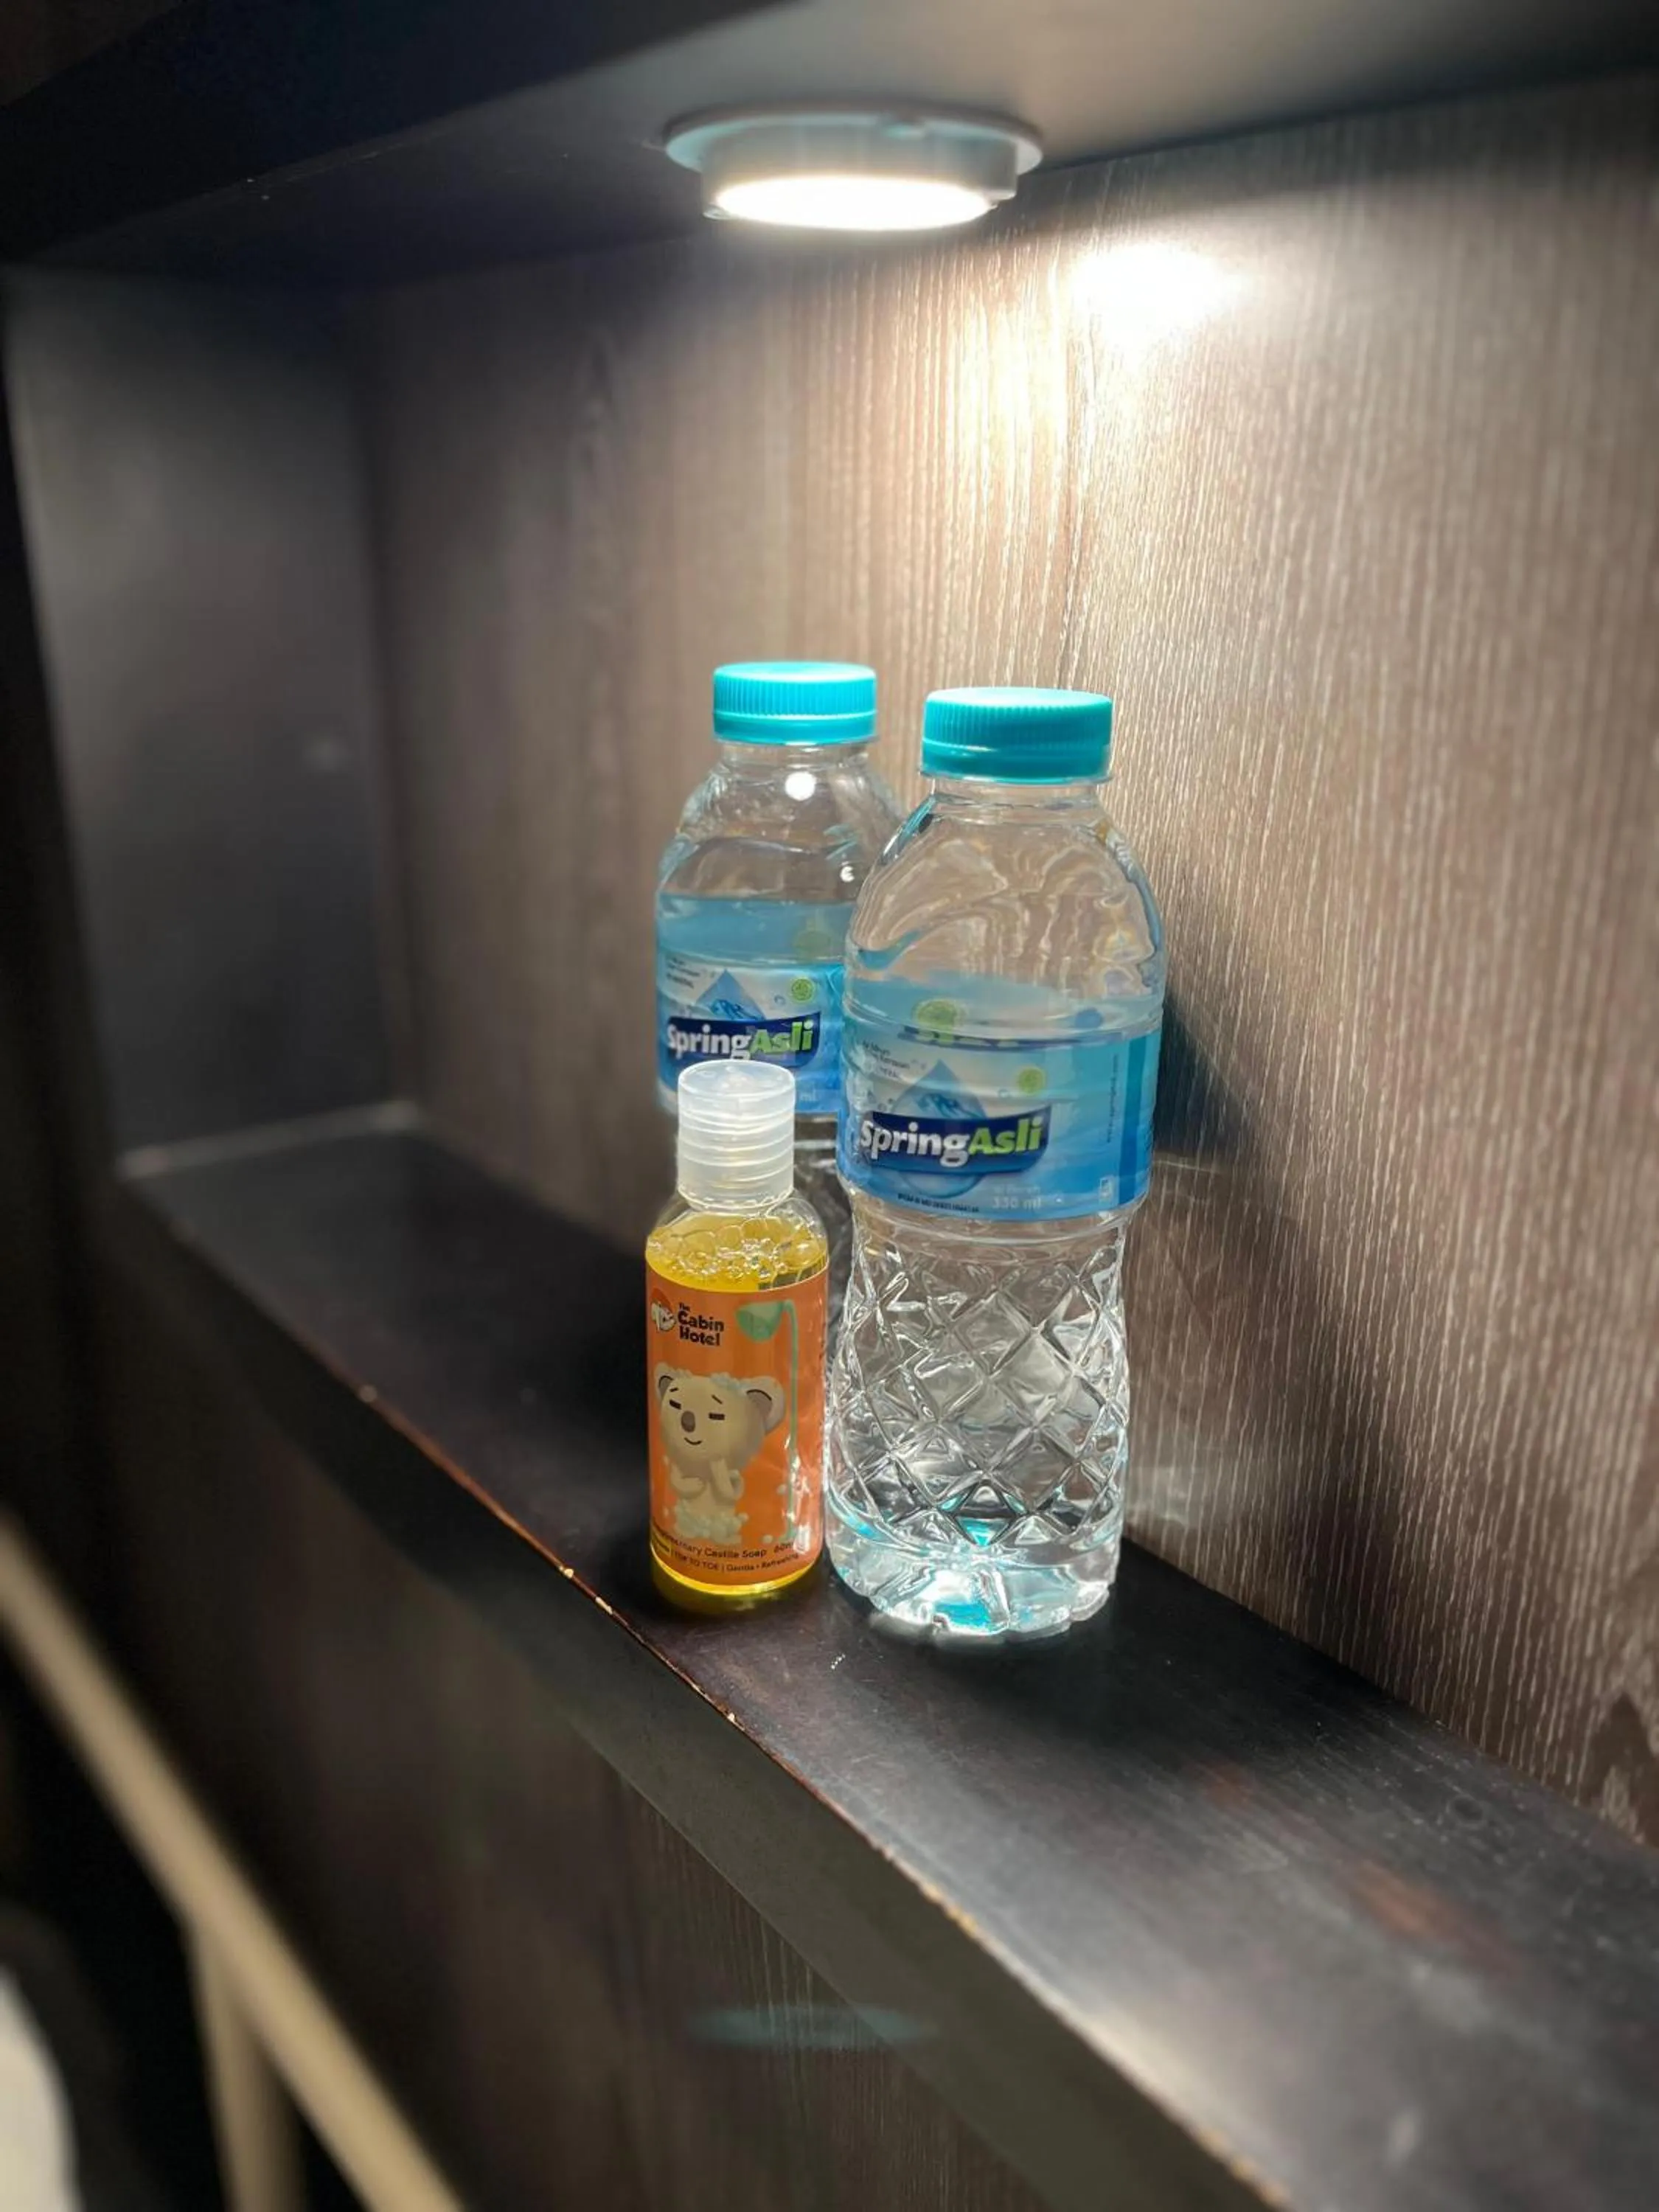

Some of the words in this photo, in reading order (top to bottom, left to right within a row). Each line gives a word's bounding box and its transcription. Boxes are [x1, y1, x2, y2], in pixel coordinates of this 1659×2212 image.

[667, 1020, 814, 1060] SpringAsli
[860, 1116, 1043, 1168] SpringAsli
[679, 1302, 691, 1312] The
[678, 1310, 725, 1332] Cabin
[680, 1325, 720, 1346] Hotel
[742, 1549, 767, 1559] Soap
